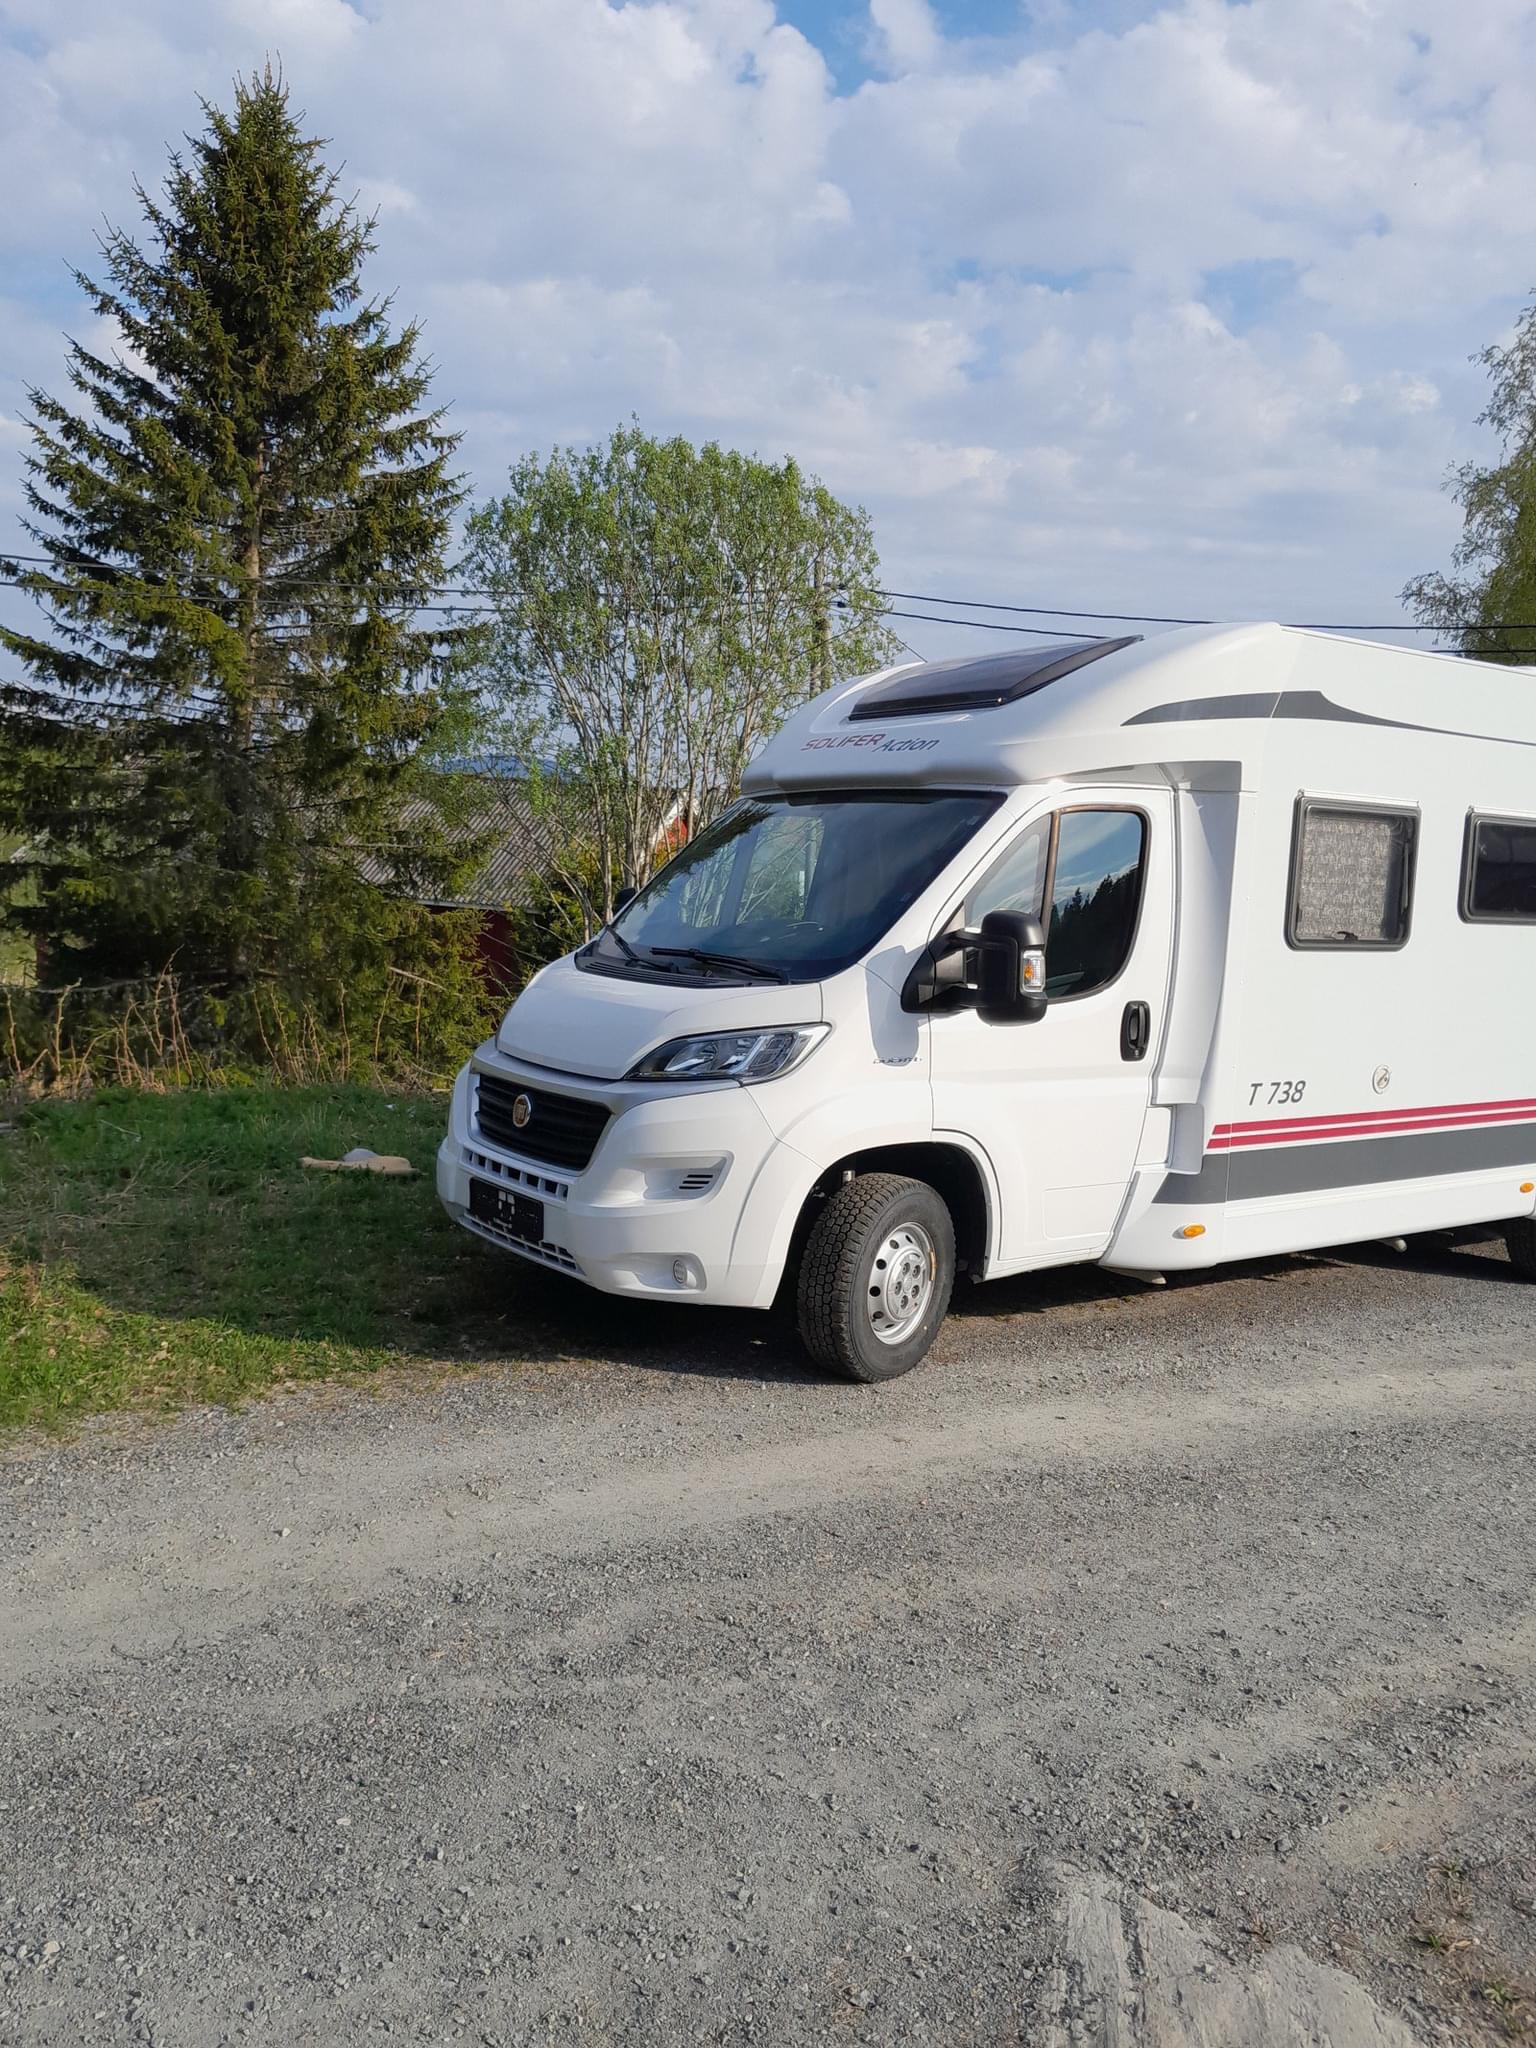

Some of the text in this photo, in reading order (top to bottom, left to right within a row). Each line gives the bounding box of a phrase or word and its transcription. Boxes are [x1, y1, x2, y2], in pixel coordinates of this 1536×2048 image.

[800, 733, 940, 752] SOLIFER Action
[1248, 1080, 1306, 1106] T 738
